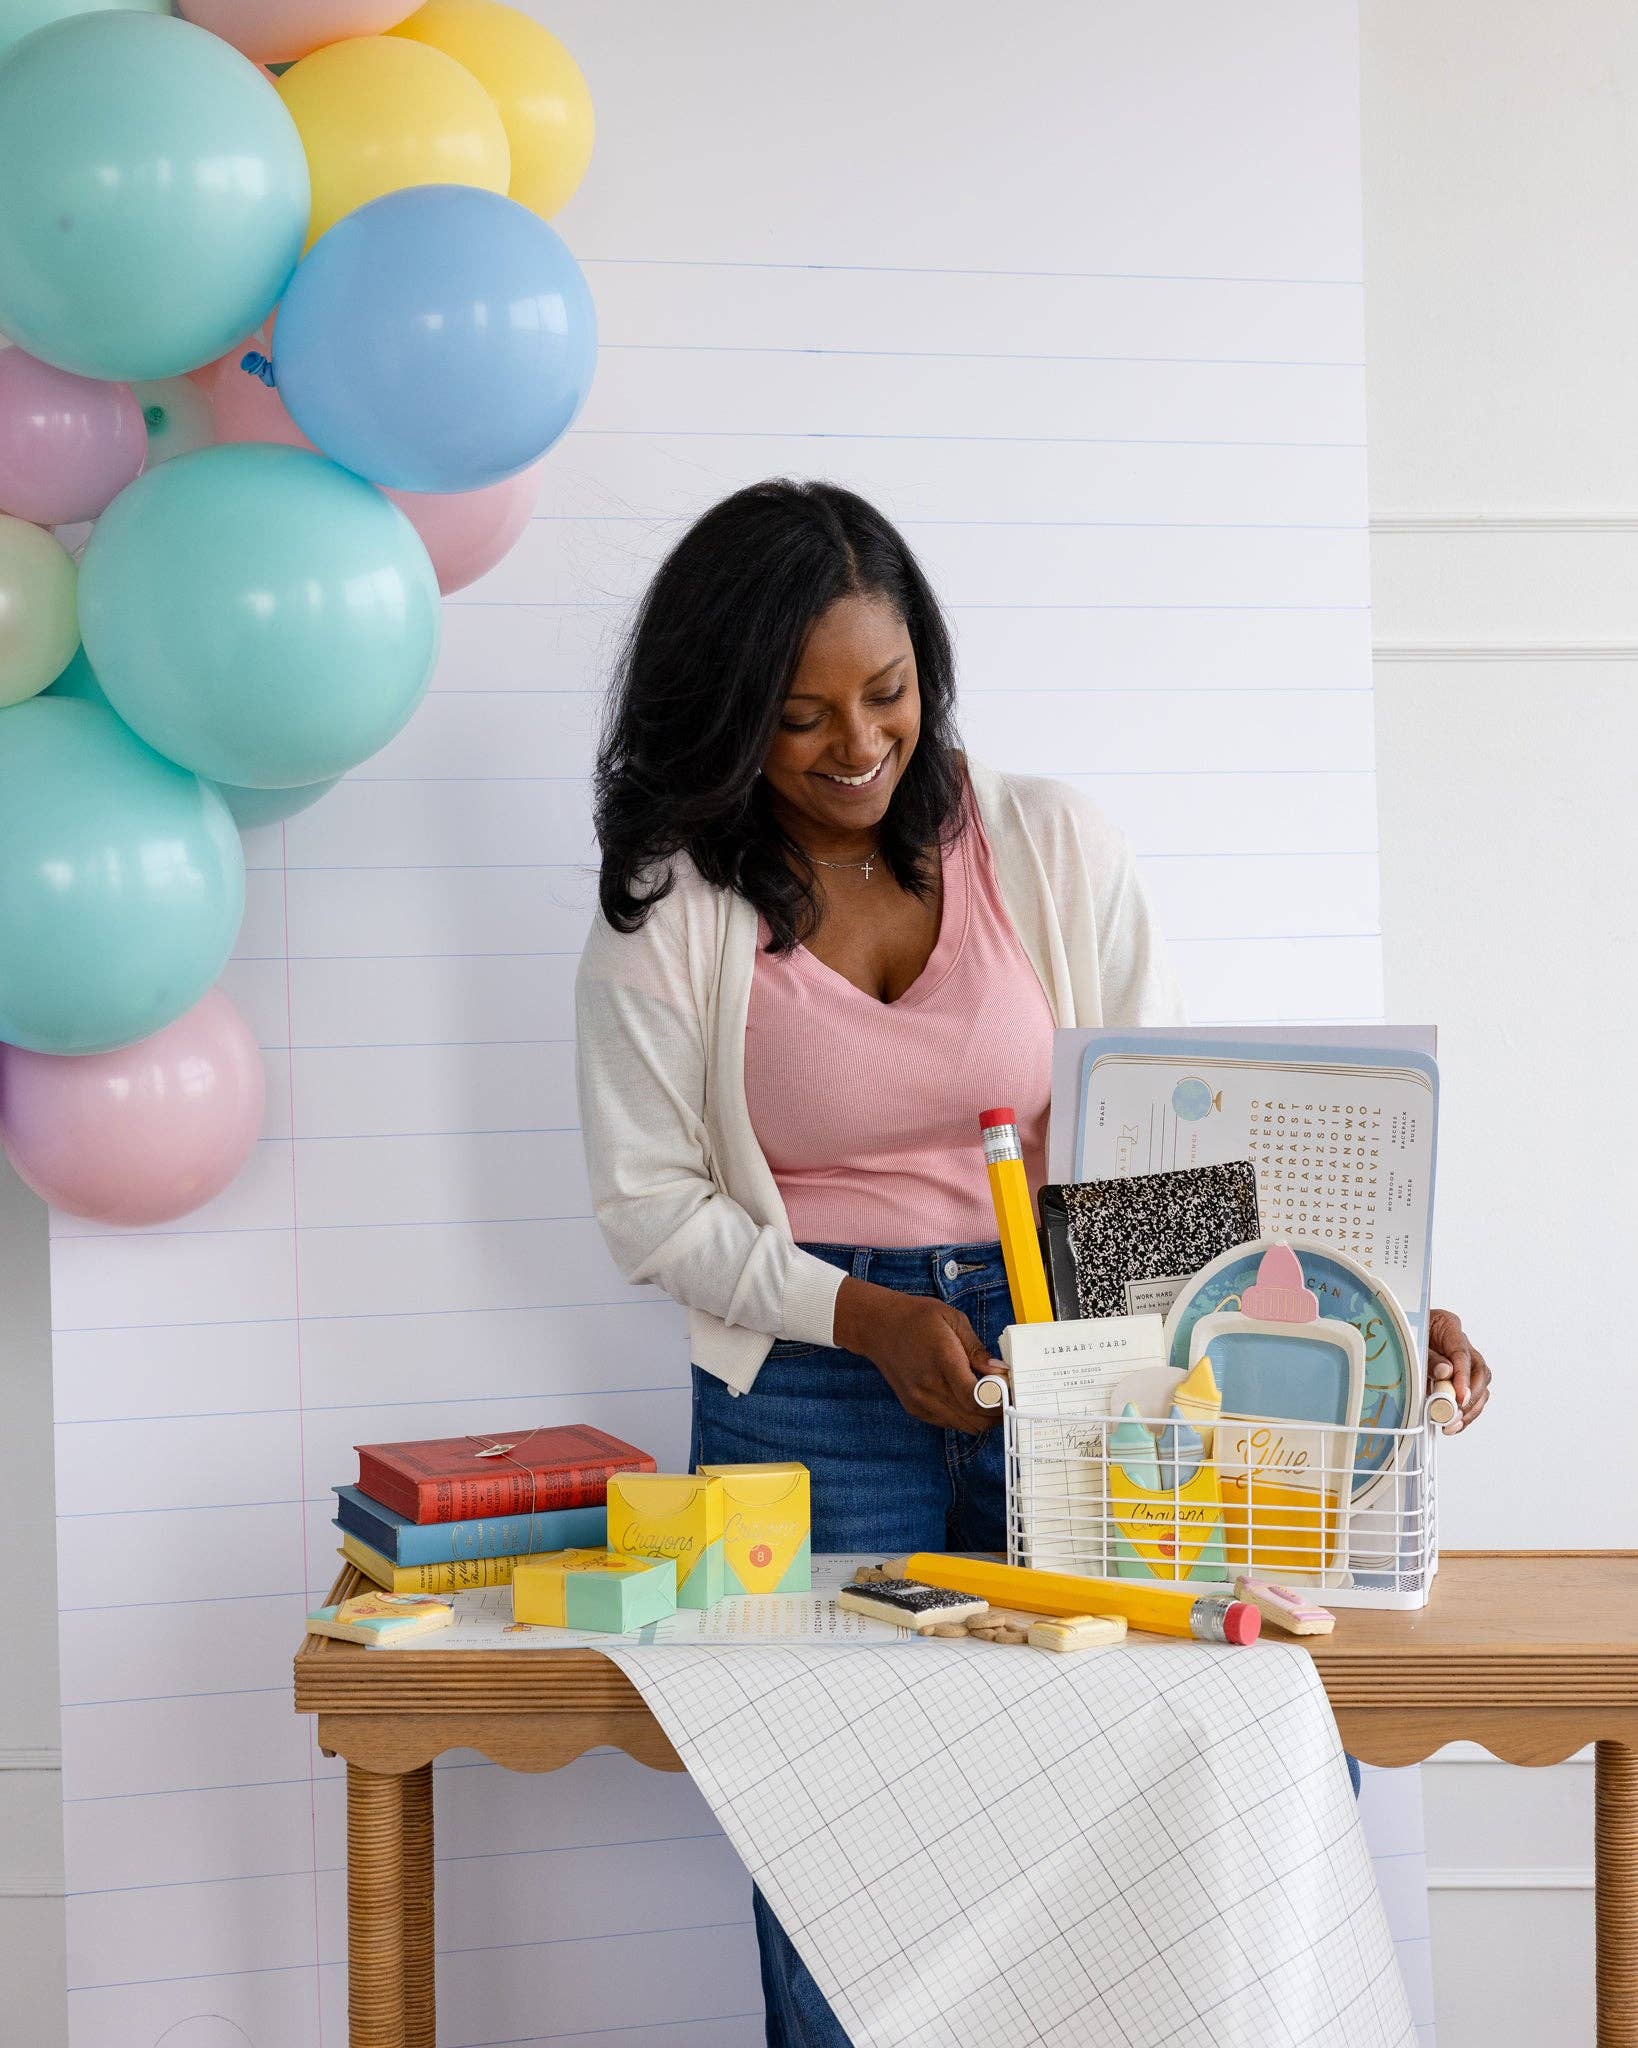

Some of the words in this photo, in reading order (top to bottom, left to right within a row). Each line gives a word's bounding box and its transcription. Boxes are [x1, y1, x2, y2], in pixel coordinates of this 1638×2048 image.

[1350, 1106, 1368, 1263] ANOTEBOOKAO
[1387, 1171, 1395, 1212] NOTEBOOK
[1135, 1293, 1154, 1301] WORK
[1155, 1290, 1173, 1298] HARD
[1306, 1277, 1344, 1299] CAN
[1043, 1343, 1095, 1355] LIBRARY
[1099, 1339, 1128, 1349] CARD
[1236, 1427, 1311, 1490] Glue
[621, 1520, 695, 1560] Crayons
